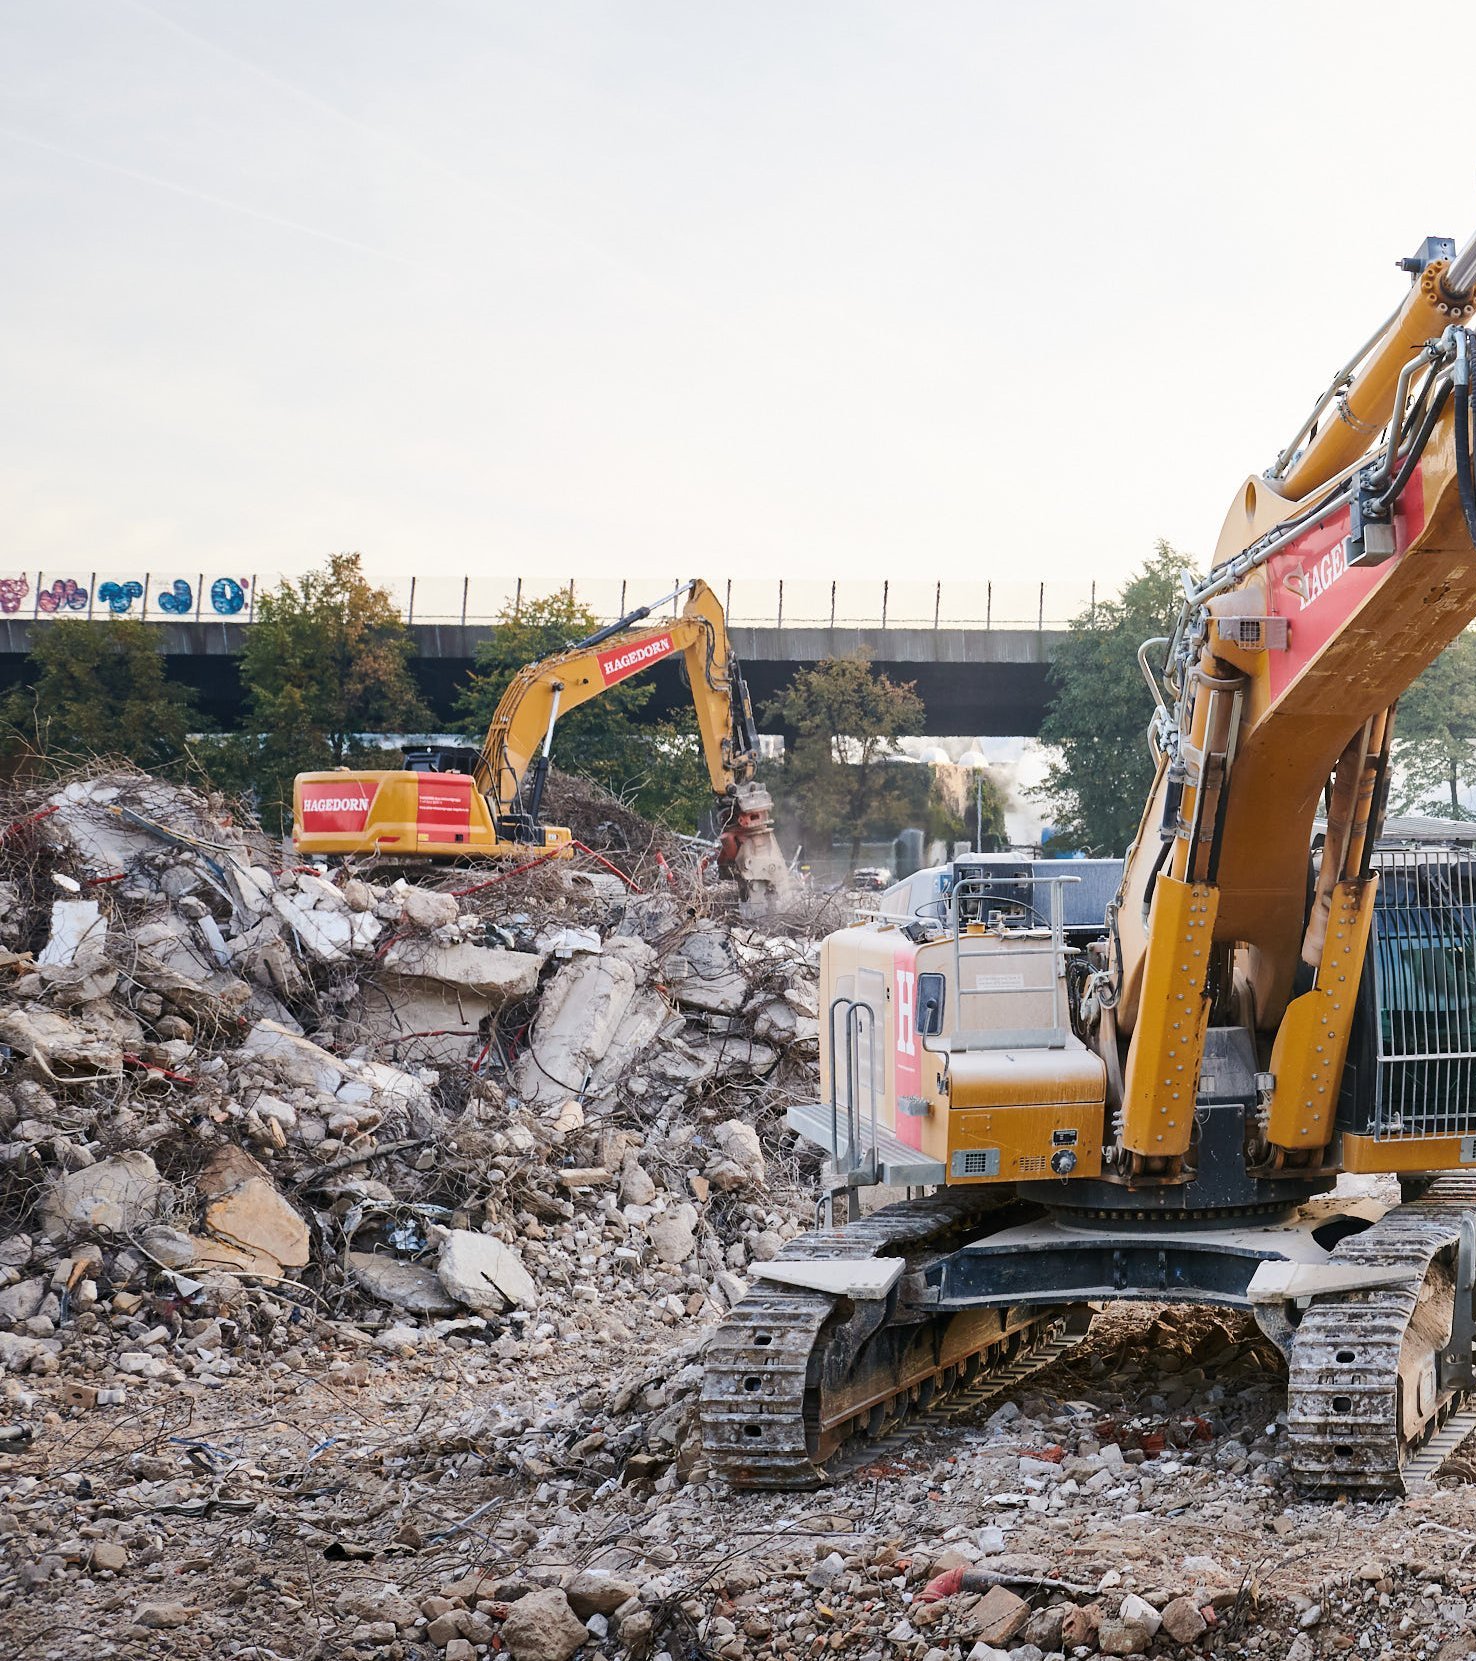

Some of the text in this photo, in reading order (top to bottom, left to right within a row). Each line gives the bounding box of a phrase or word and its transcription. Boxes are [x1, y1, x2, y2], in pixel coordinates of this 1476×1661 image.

[603, 638, 670, 675] HAGEDORN
[303, 798, 369, 812] HAGEDORN
[896, 969, 915, 1057] H
